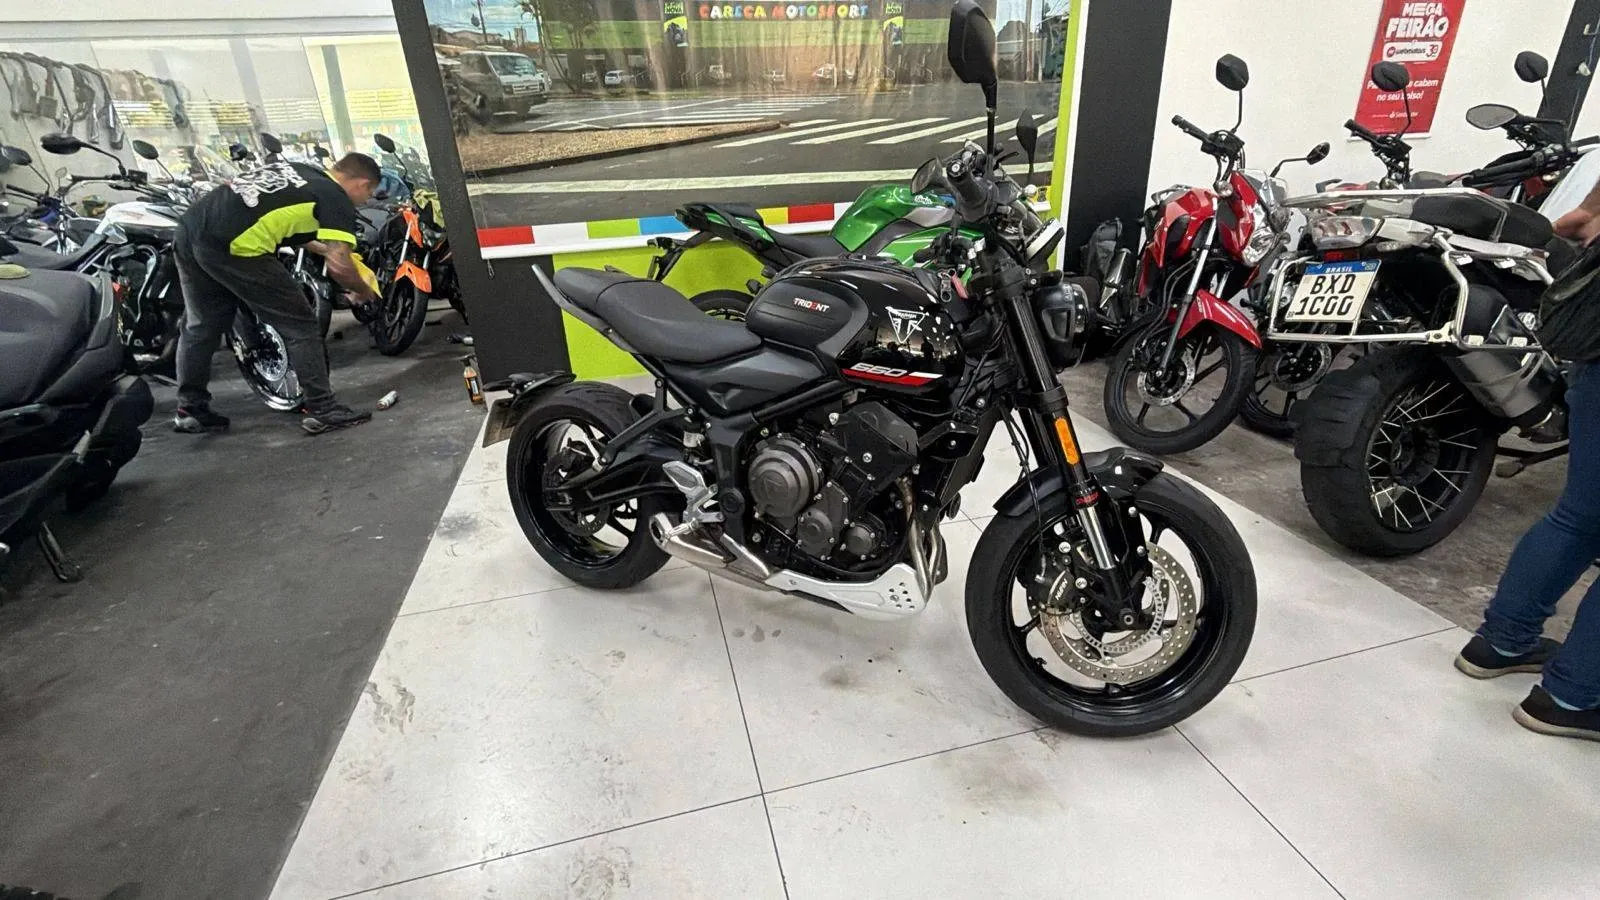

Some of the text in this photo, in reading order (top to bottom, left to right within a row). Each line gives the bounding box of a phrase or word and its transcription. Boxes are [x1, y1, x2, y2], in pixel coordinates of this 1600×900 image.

[699, 5, 767, 18] CARECA
[1402, 2, 1442, 16] MEGA
[1386, 14, 1449, 38] FEIRÃO
[1413, 78, 1439, 87] cabem
[1388, 92, 1401, 100] seu
[1325, 266, 1353, 274] BRASIL
[1310, 273, 1357, 294] BXD
[792, 297, 830, 312] TRIDENT
[850, 362, 908, 377] 660
